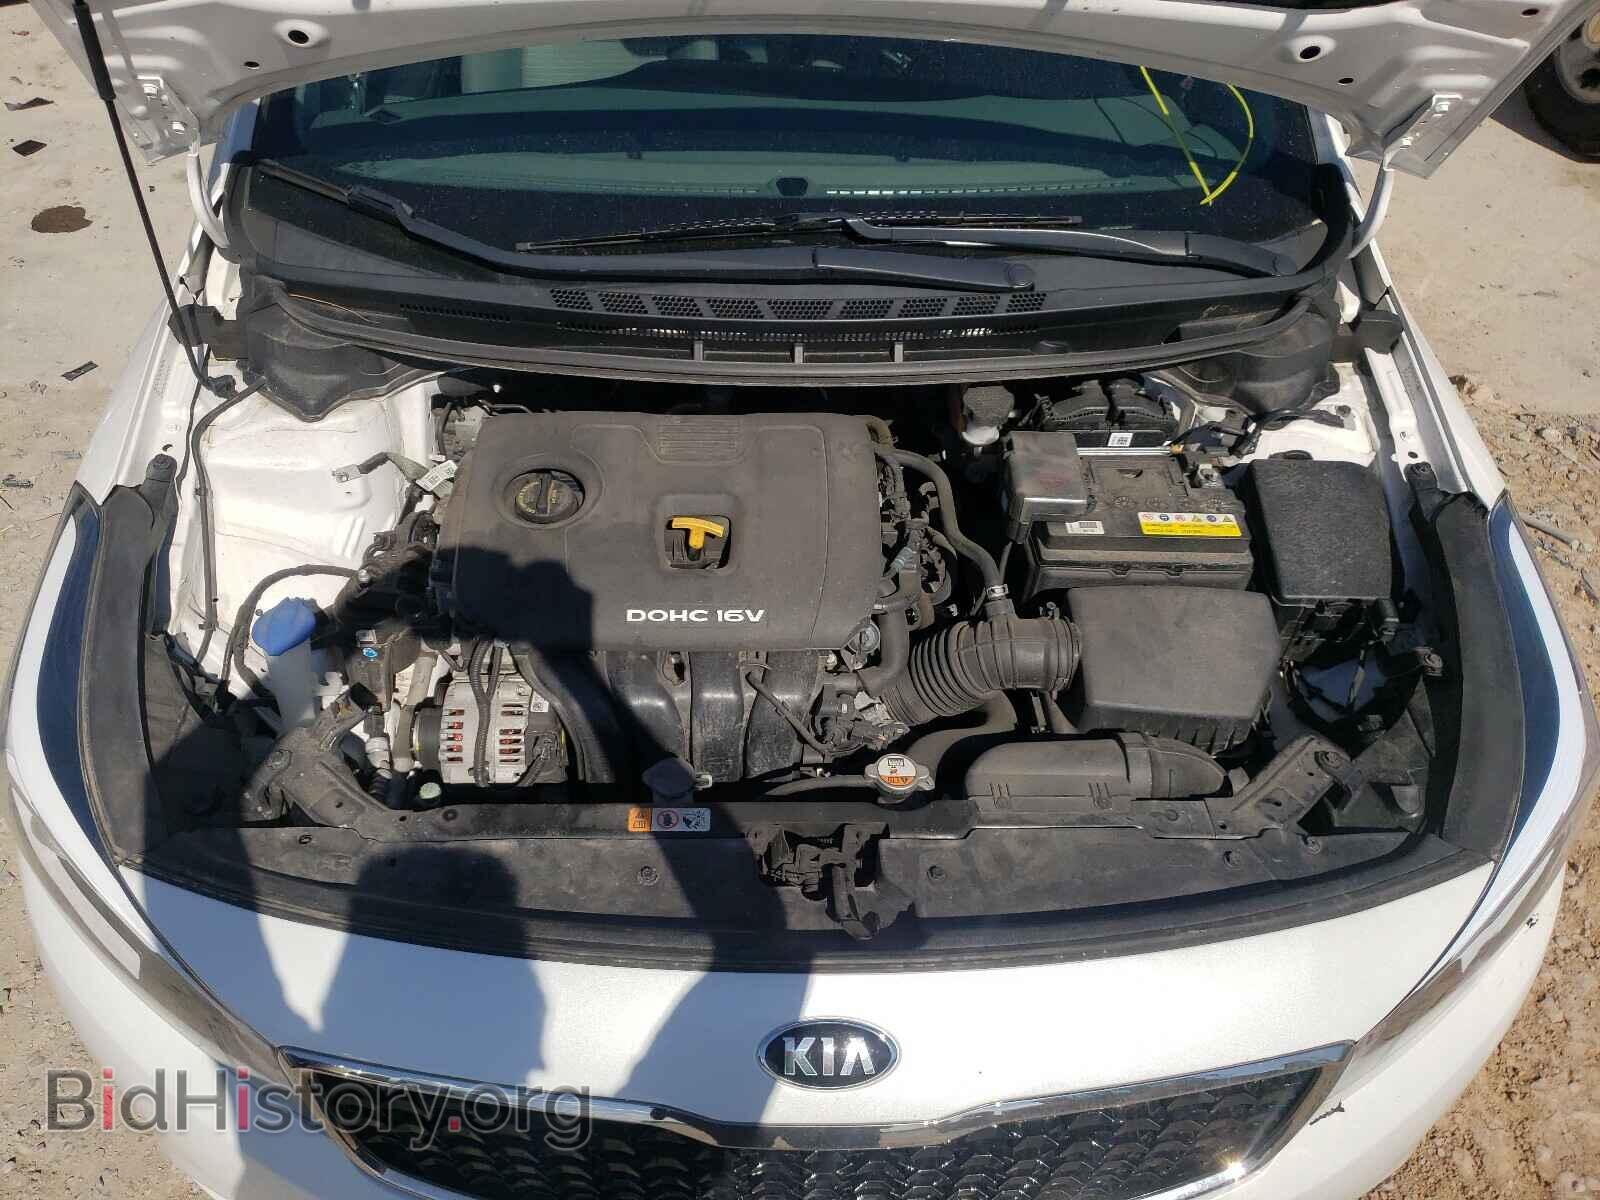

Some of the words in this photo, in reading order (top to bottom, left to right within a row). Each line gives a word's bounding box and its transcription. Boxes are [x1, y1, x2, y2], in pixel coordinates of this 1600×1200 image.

[626, 609, 709, 623] DOHC
[717, 609, 765, 623] 16V
[782, 1036, 876, 1076] KIA
